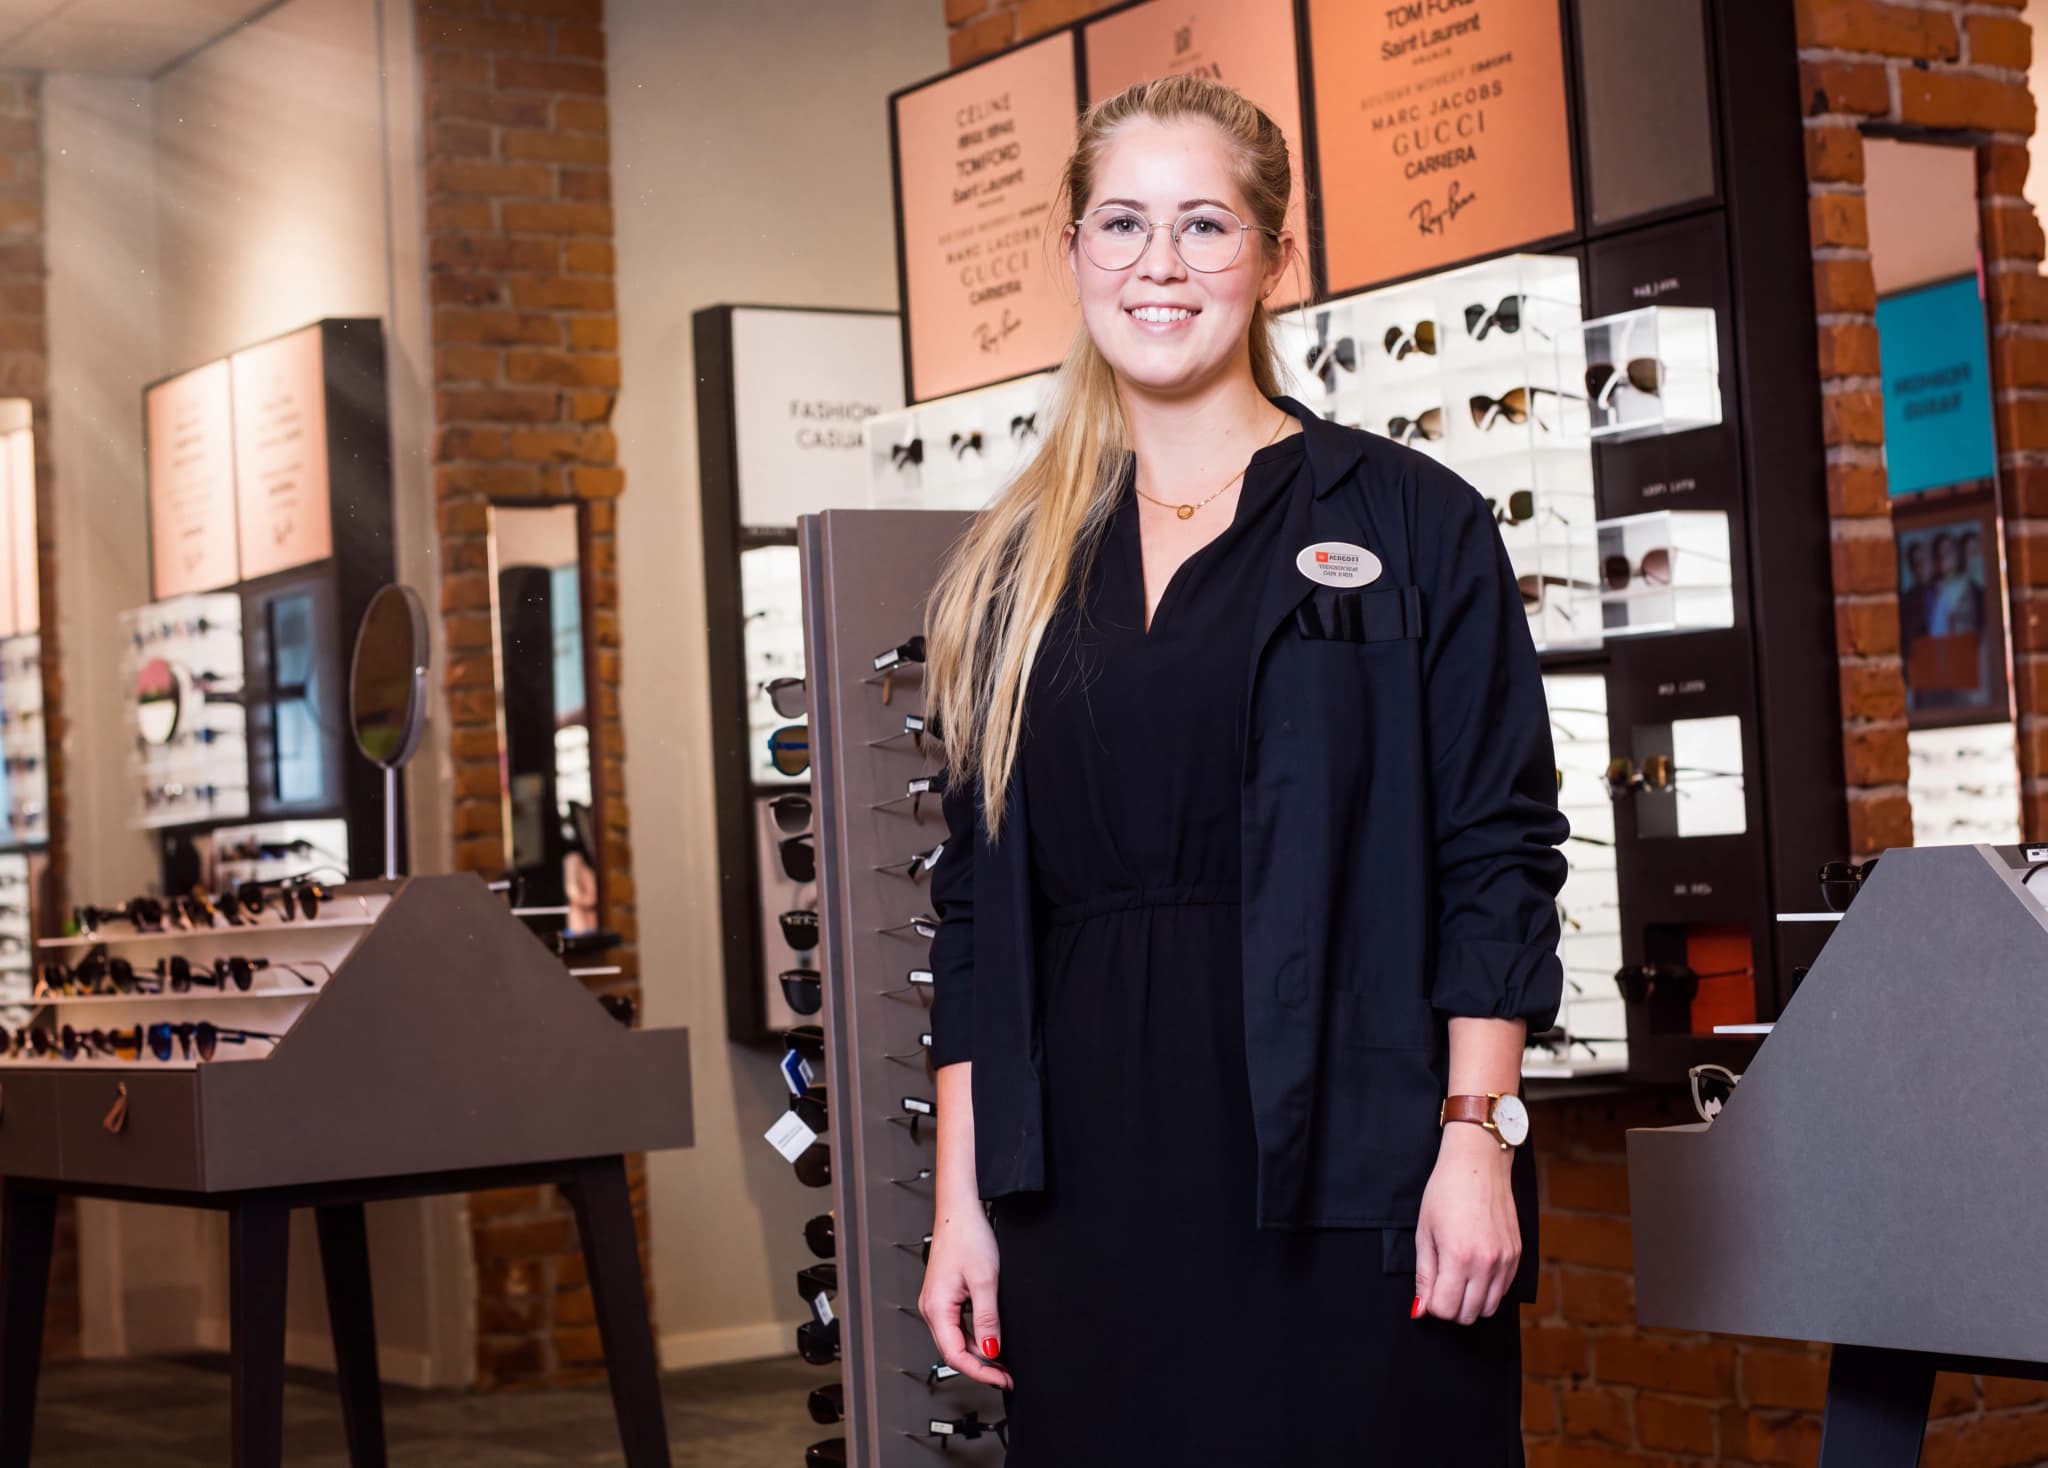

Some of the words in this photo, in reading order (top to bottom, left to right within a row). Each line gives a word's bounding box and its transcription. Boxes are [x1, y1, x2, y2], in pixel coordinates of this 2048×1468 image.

[1386, 1, 1423, 29] TOM
[1382, 33, 1417, 61] Saint
[1420, 12, 1481, 48] Laurent
[1371, 104, 1420, 130] MARC
[1430, 79, 1503, 116] JACOBS
[1392, 110, 1485, 156] GUCCI
[1404, 145, 1477, 180] CARRERA
[790, 400, 880, 422] FASHION
[796, 428, 864, 450] CASUA
